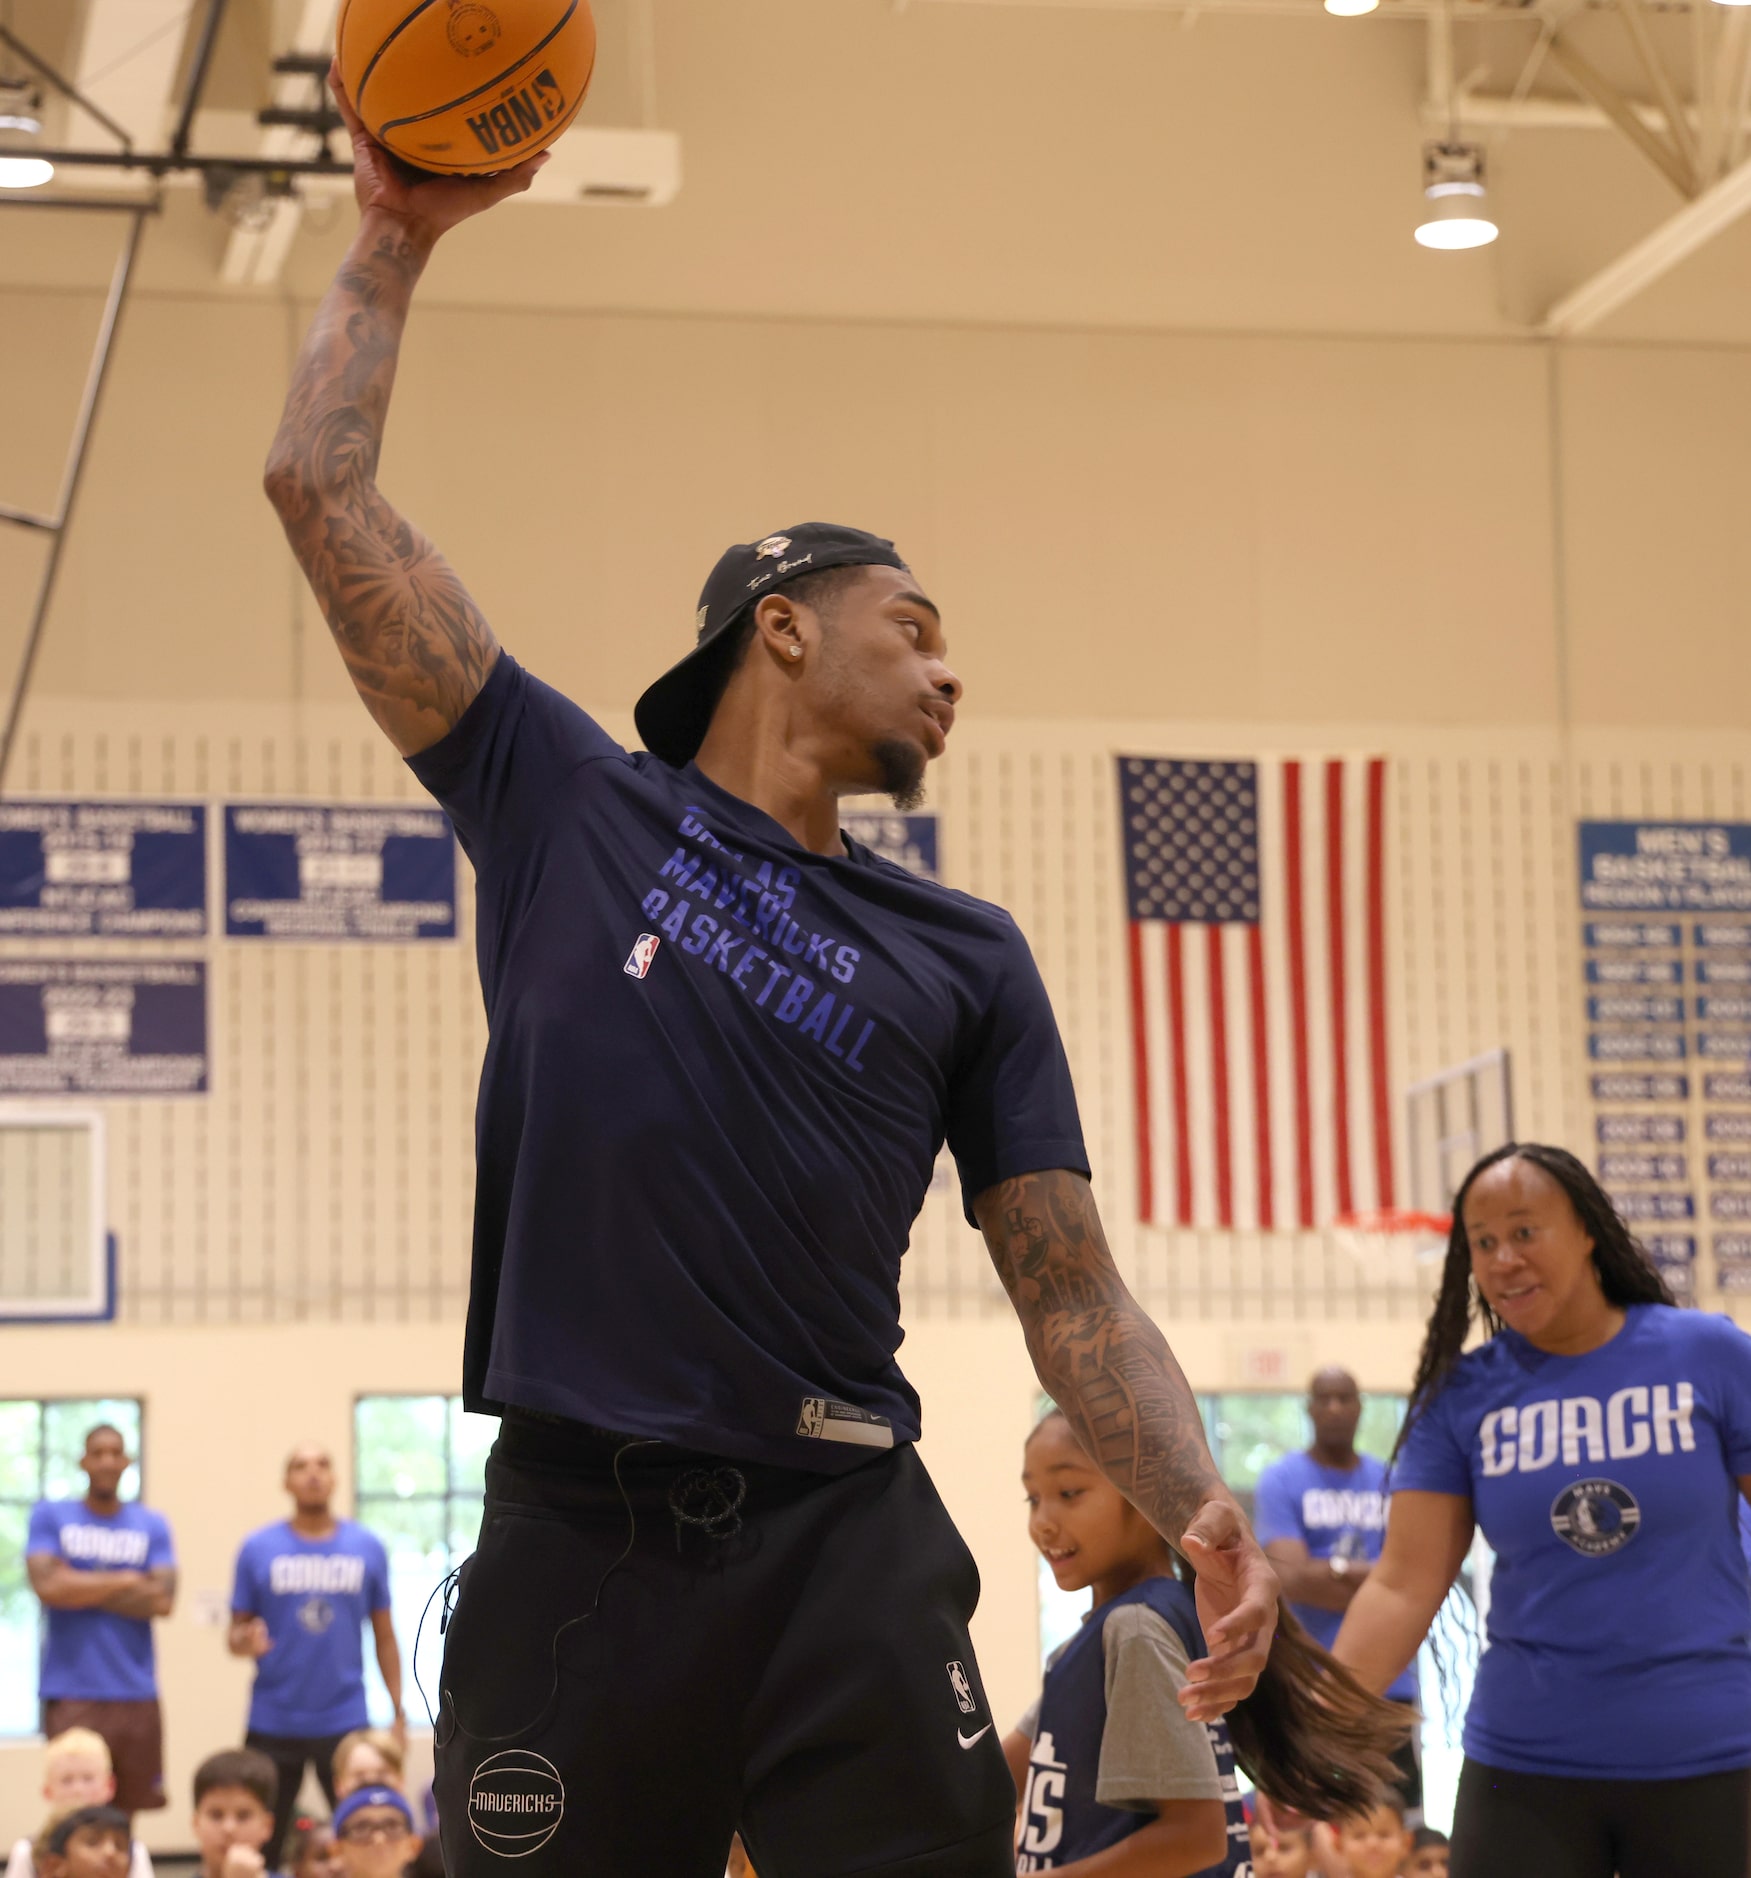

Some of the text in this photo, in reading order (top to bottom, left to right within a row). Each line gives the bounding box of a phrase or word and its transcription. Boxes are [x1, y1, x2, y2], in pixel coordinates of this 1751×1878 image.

[467, 93, 543, 155] NBA
[658, 847, 860, 983] MAVERICKS
[641, 887, 876, 1072] BASKETBALL
[1480, 1382, 1696, 1477] COACH
[270, 1554, 365, 1595] COACH
[475, 1791, 555, 1813] MAVERICKS
